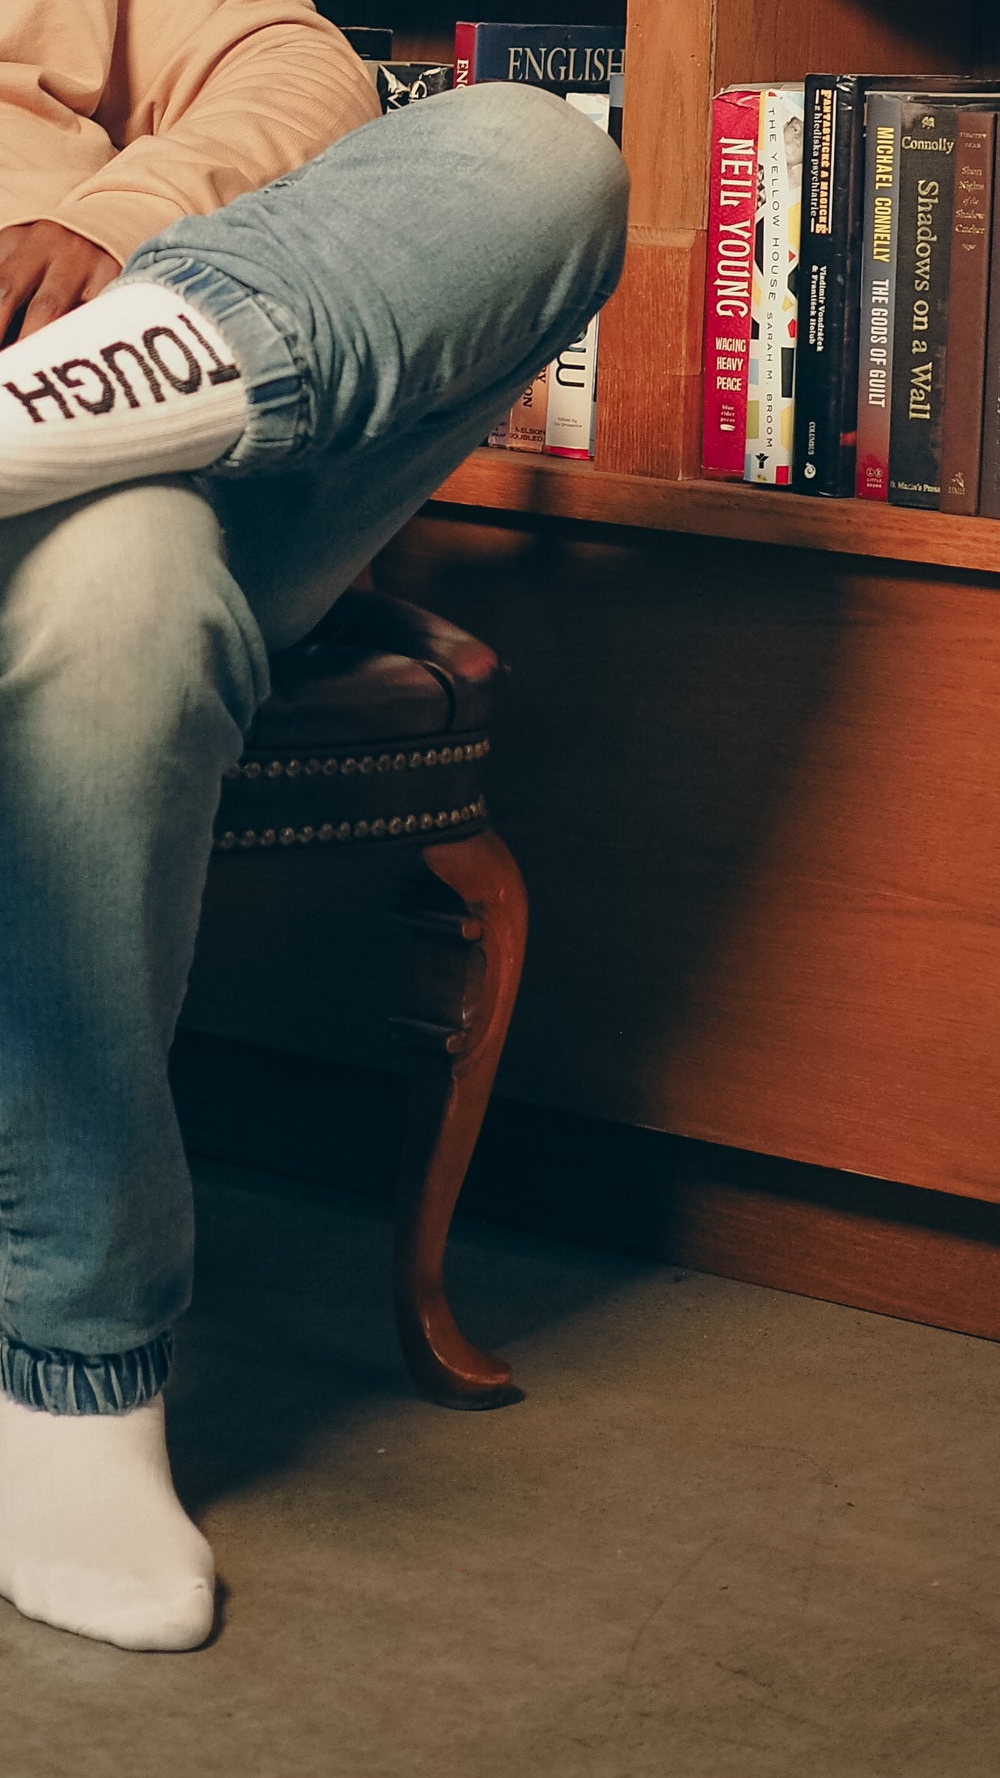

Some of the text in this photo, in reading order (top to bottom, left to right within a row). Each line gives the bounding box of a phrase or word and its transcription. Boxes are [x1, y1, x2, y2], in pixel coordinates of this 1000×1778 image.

[508, 46, 625, 81] ENGLISH
[812, 113, 821, 157] hlediska
[902, 136, 954, 154] Connolly
[771, 153, 779, 226] YELLOW
[810, 159, 820, 216] psychiatrie
[713, 136, 754, 319] NEIL YOUNG
[768, 237, 779, 301] HOUSE
[867, 127, 894, 408] MICHAEL CONNELLY THE GODS OF GUILT
[909, 179, 939, 420] Shadows on a Wall
[716, 337, 746, 352] WAGING
[766, 312, 774, 365] SARAH
[809, 318, 817, 345] Holub
[2, 314, 241, 423] TOUGH
[717, 357, 743, 371] HEAVY
[717, 376, 742, 391] PEACE
[766, 369, 773, 385] M.
